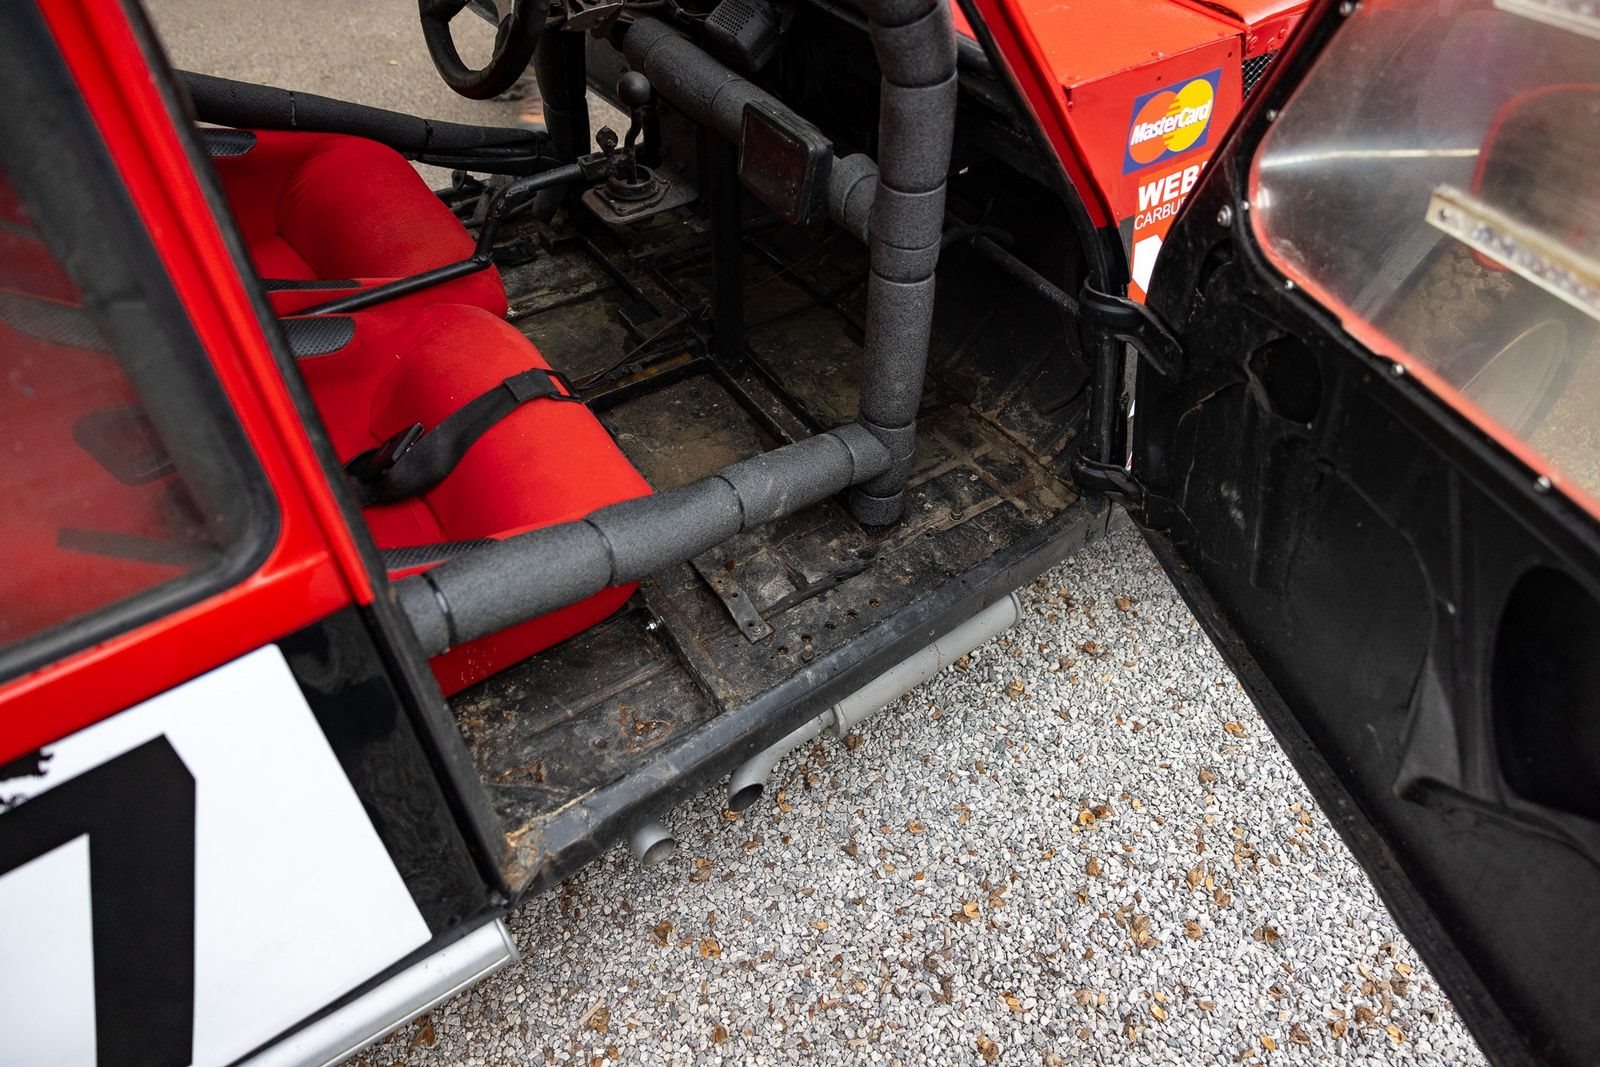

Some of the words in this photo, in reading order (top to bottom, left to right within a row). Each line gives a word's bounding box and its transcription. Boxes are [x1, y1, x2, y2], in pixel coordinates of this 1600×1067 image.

[1130, 99, 1213, 146] MasterCard
[1138, 161, 1208, 212] WEB
[1134, 196, 1187, 230] CARBU
